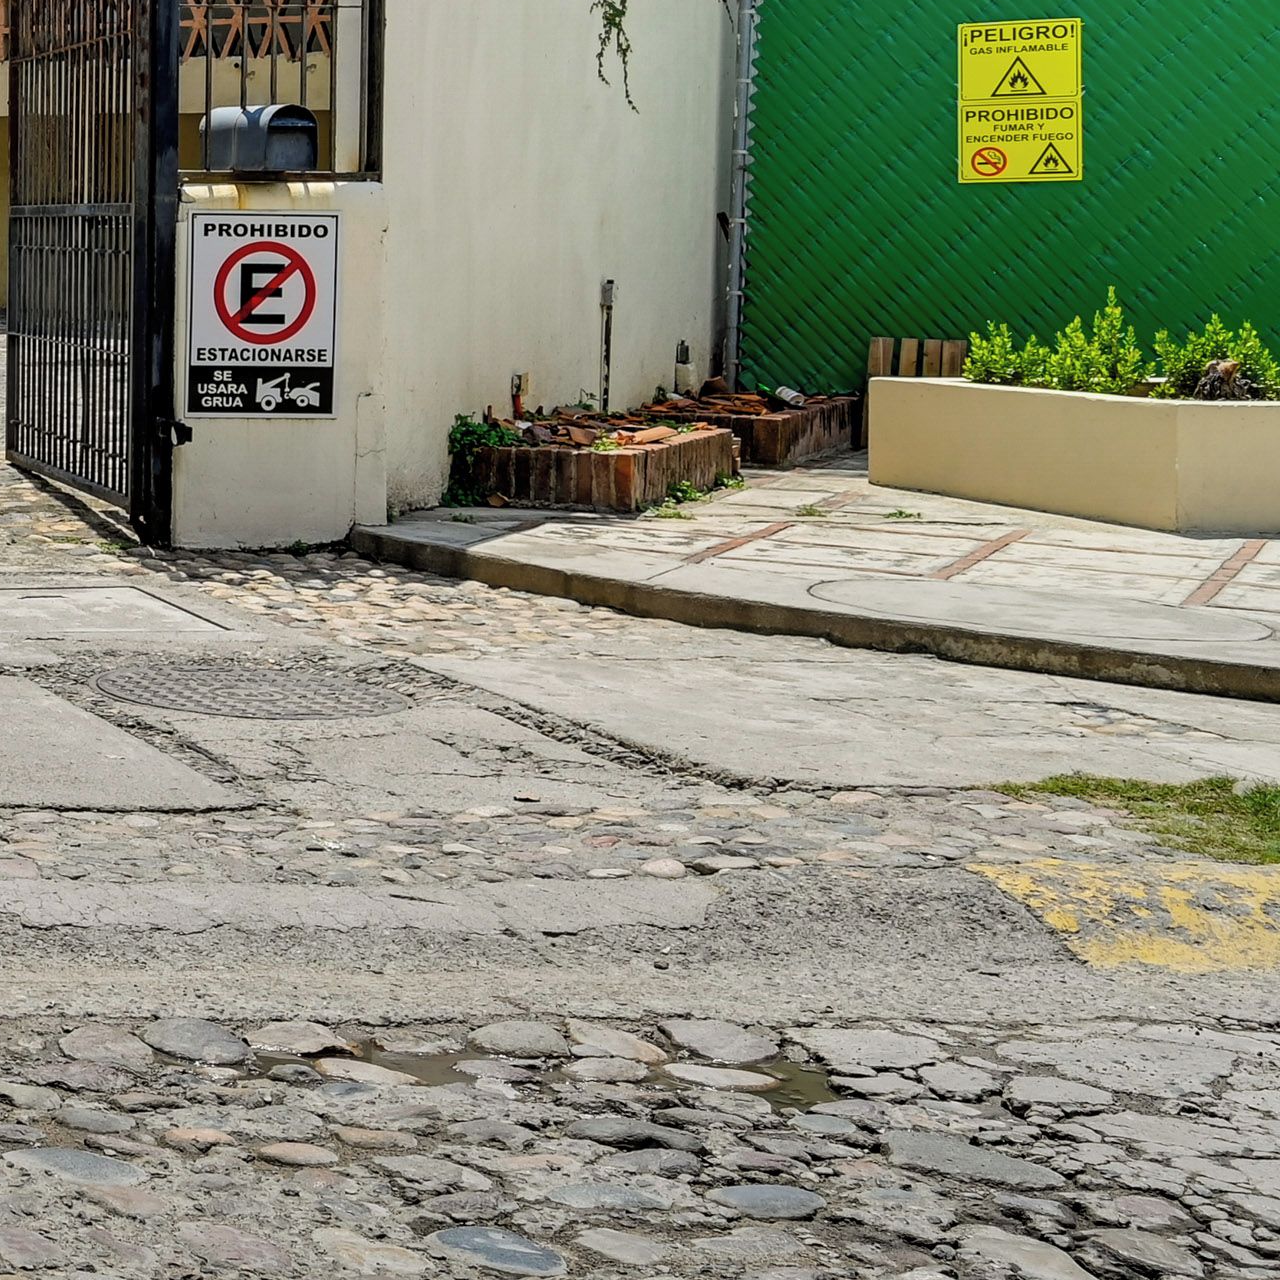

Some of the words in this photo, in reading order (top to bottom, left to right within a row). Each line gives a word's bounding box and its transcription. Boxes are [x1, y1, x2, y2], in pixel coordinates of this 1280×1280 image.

[963, 24, 1075, 47] ¡PELIGRO!
[969, 47, 993, 55] GAS
[996, 43, 1069, 54] INFLAMABLE
[965, 107, 1074, 122] PROHIBIDO
[993, 123, 1034, 132] FUMAR
[1038, 123, 1045, 131] Y
[965, 134, 1029, 143] ENCENDER
[1032, 132, 1074, 141] FUEGO
[203, 223, 329, 238] PROHIBIDO
[196, 348, 328, 362] ESTACIONARSE
[213, 370, 232, 382] SE
[197, 383, 248, 395] USARA
[201, 396, 243, 408] GRUA
